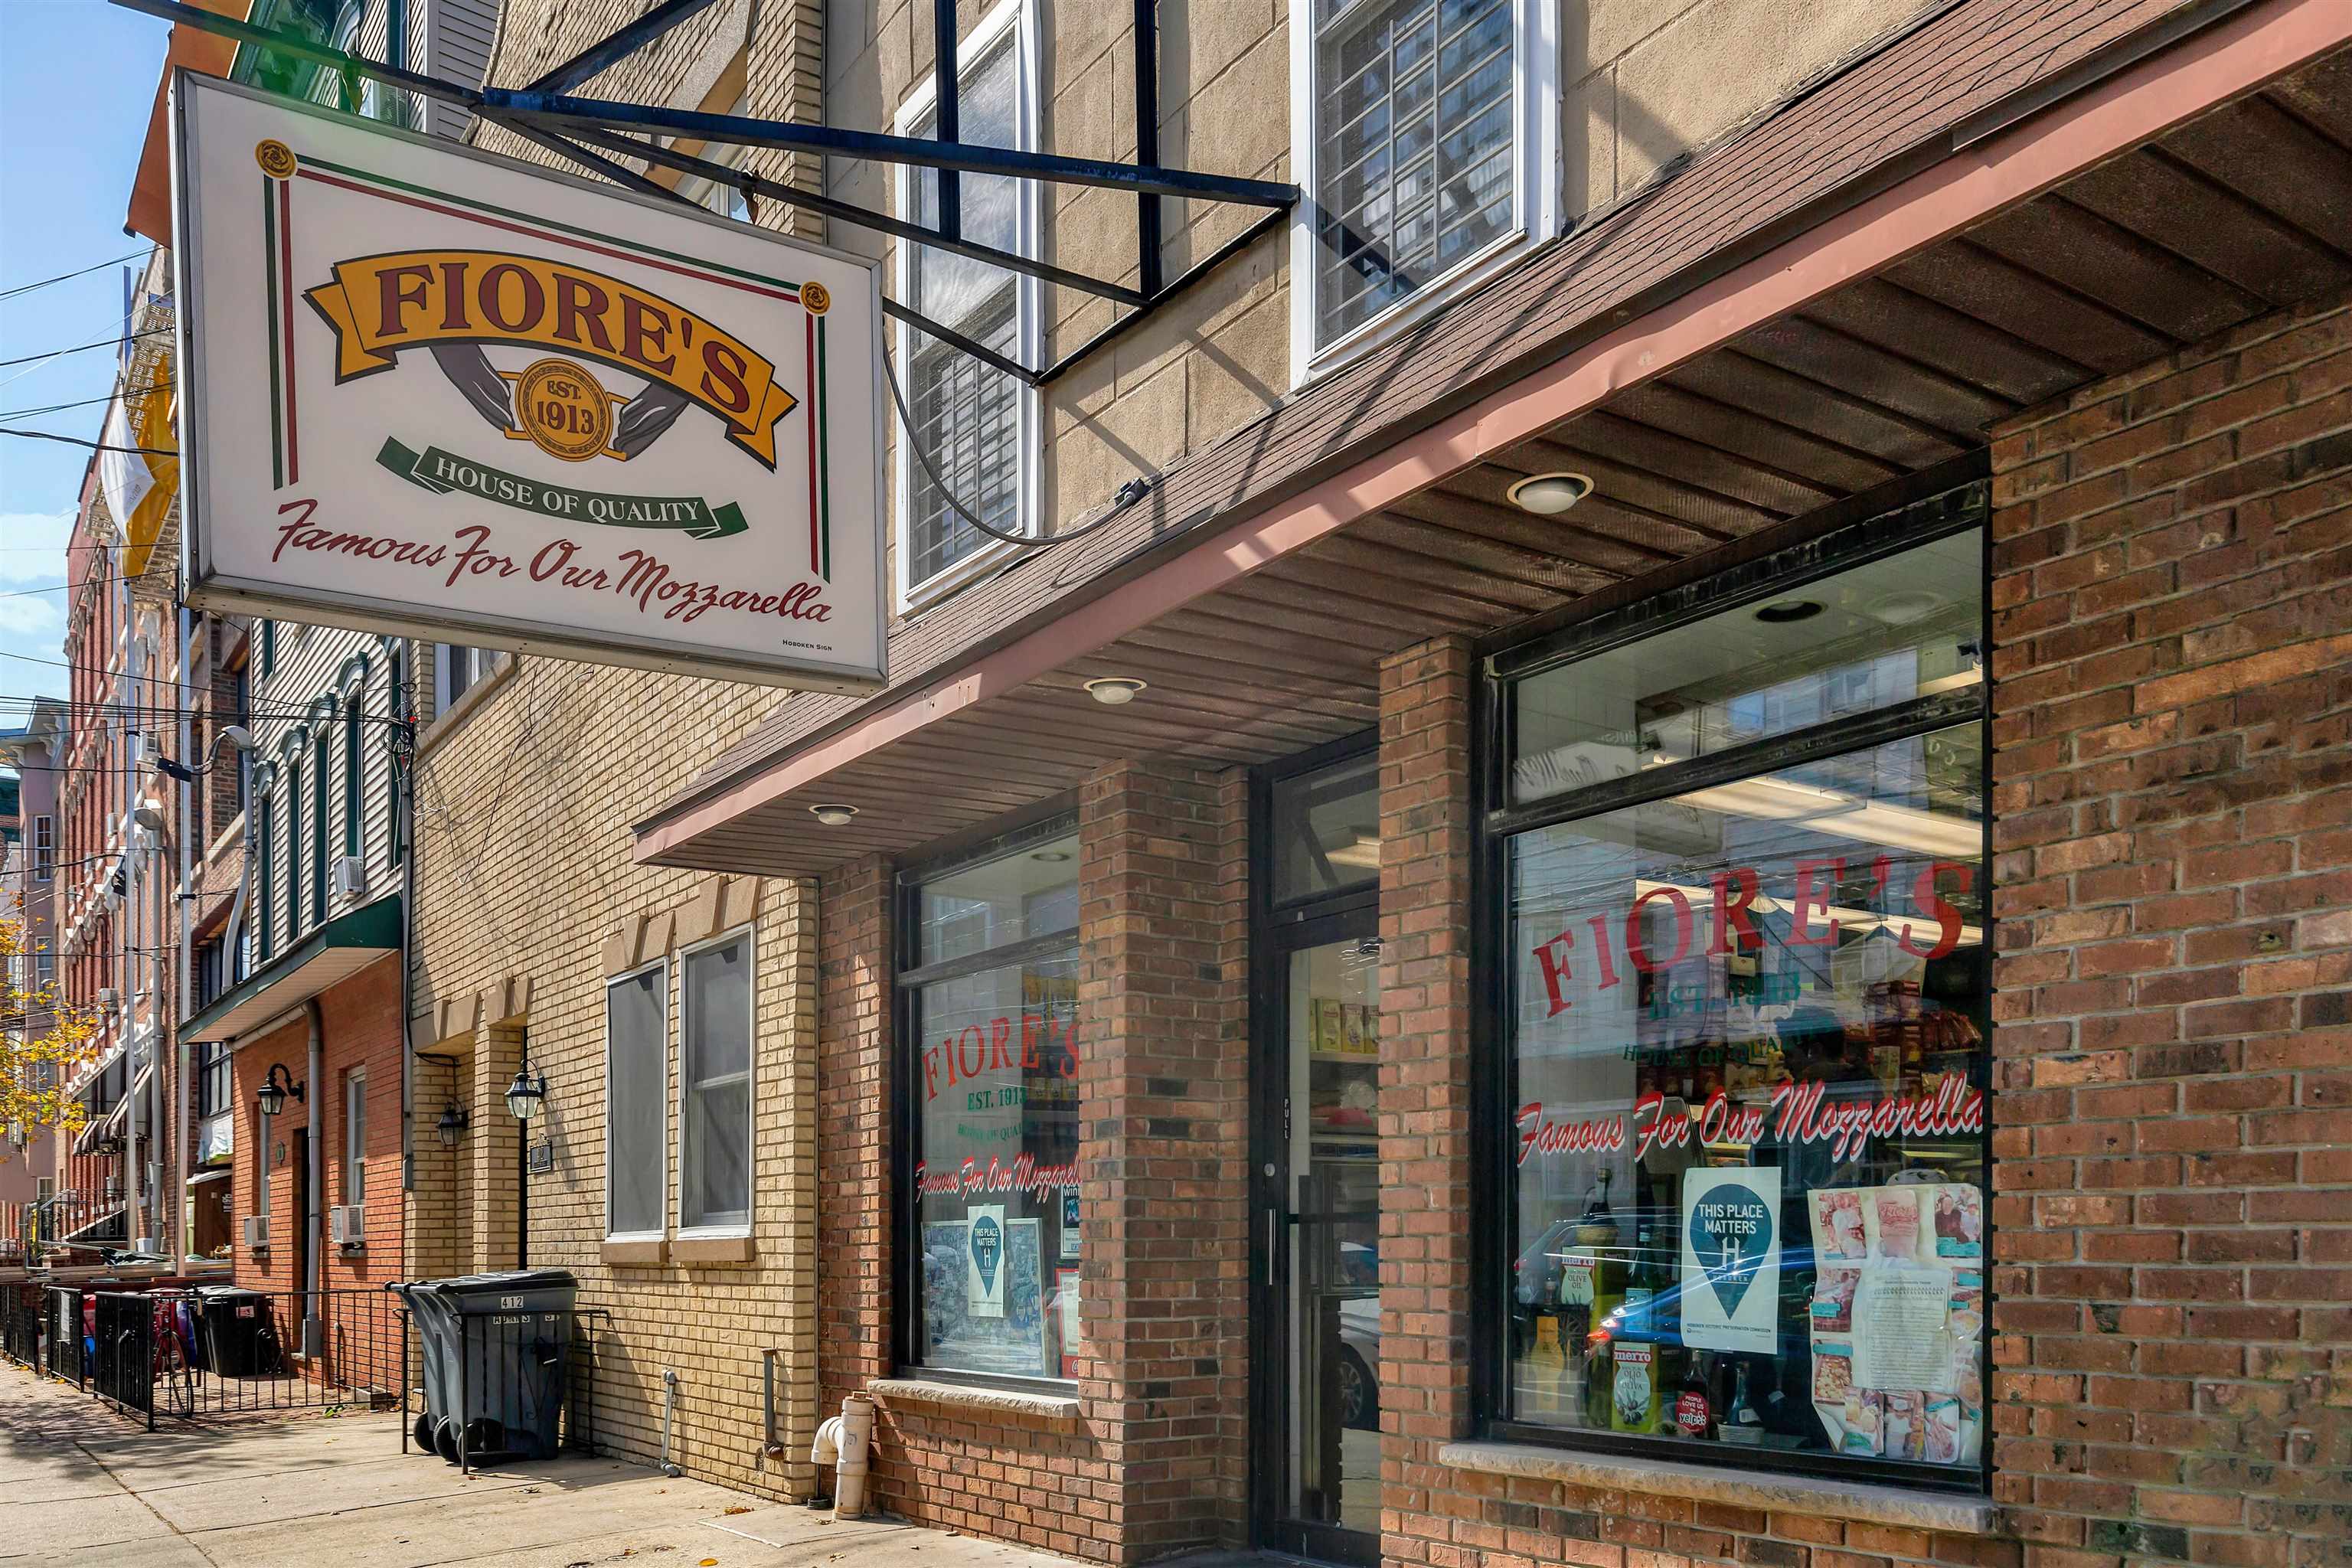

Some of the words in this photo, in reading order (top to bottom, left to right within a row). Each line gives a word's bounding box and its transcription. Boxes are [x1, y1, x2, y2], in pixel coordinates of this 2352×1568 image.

[374, 262, 750, 413] FIORE'S
[547, 380, 582, 400] EST.
[537, 400, 595, 435] 1913
[435, 456, 534, 506] HOUSE
[542, 490, 580, 514] OF
[588, 498, 700, 524] QUALITY
[272, 498, 447, 567] Famous
[445, 525, 521, 587] For
[529, 538, 611, 590] Our
[616, 549, 832, 622] Mozzarella
[1532, 854, 1973, 1018] FIORE'S
[968, 1090, 995, 1111] EST.
[998, 1086, 1029, 1107] 1913
[1516, 1101, 1625, 1168] Famous
[1633, 1090, 1690, 1163] For
[1699, 1085, 1765, 1148] Our
[1770, 1070, 1983, 1163] Mozzarella
[914, 1158, 960, 1203] Famous
[962, 1155, 984, 1201] For
[987, 1153, 1012, 1194] Our
[1014, 1151, 1082, 1204] Mozzarell
[1698, 1204, 1725, 1217] THIS
[1726, 1204, 1764, 1218] PLACE
[975, 1228, 984, 1236] THIS
[984, 1228, 999, 1237] PLACE
[1704, 1220, 1757, 1235] MATTERS
[977, 1238, 997, 1246] MATTERS
[1567, 1274, 1587, 1283] OLIVE
[502, 1297, 522, 1308] 412
